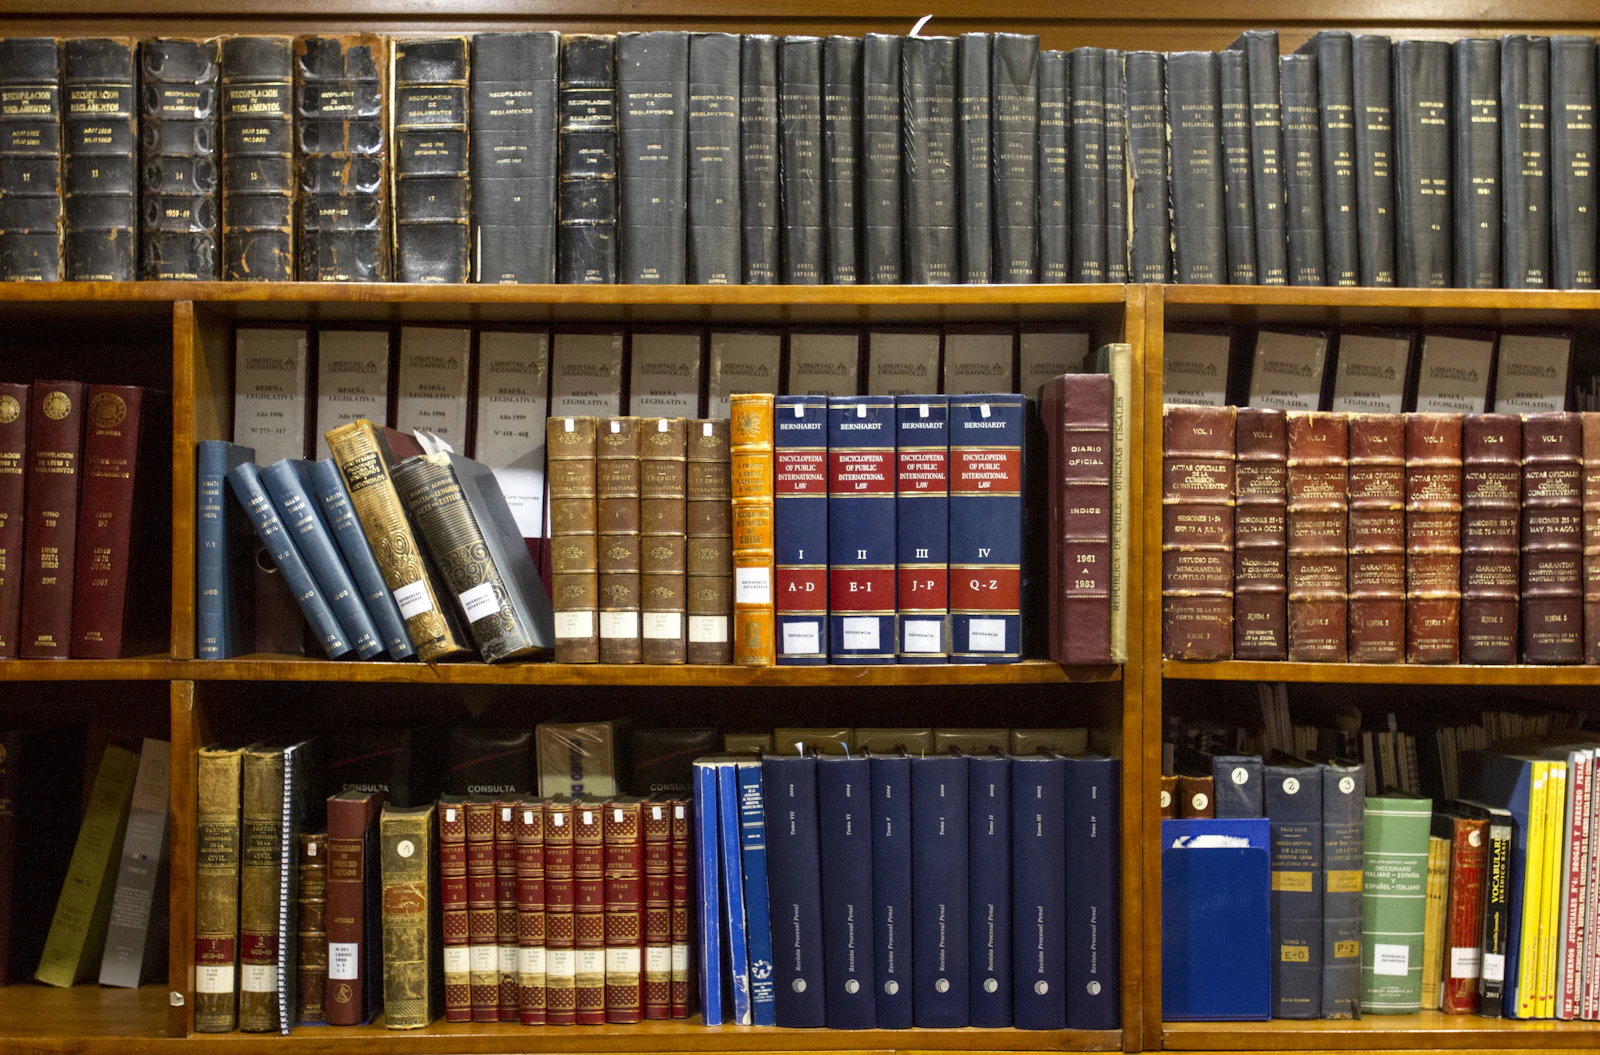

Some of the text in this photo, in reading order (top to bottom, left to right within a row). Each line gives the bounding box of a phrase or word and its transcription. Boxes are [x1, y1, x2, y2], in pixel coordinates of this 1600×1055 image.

[3, 92, 50, 100] RECOPILACION
[231, 89, 278, 98] RECOPILACION
[71, 103, 119, 112] REGLAMENTOS
[232, 103, 280, 112] REGLAMENTOS
[1344, 399, 1390, 408] LEGISLATIVA
[740, 536, 762, 544] CHILE
[1114, 538, 1121, 550] DE
[799, 550, 803, 559] I
[858, 550, 866, 559] II
[916, 549, 928, 558] III
[978, 549, 990, 557] IV
[1236, 772, 1242, 781] 1
[468, 784, 515, 793] CONSULTA
[1288, 780, 1295, 790] 2
[1344, 780, 1351, 790] 3
[1196, 798, 1203, 806] 2
[1572, 841, 1580, 872] DROGAS
[1569, 898, 1577, 943] JUDICIALES
[1566, 948, 1575, 994] CUADERNOS
